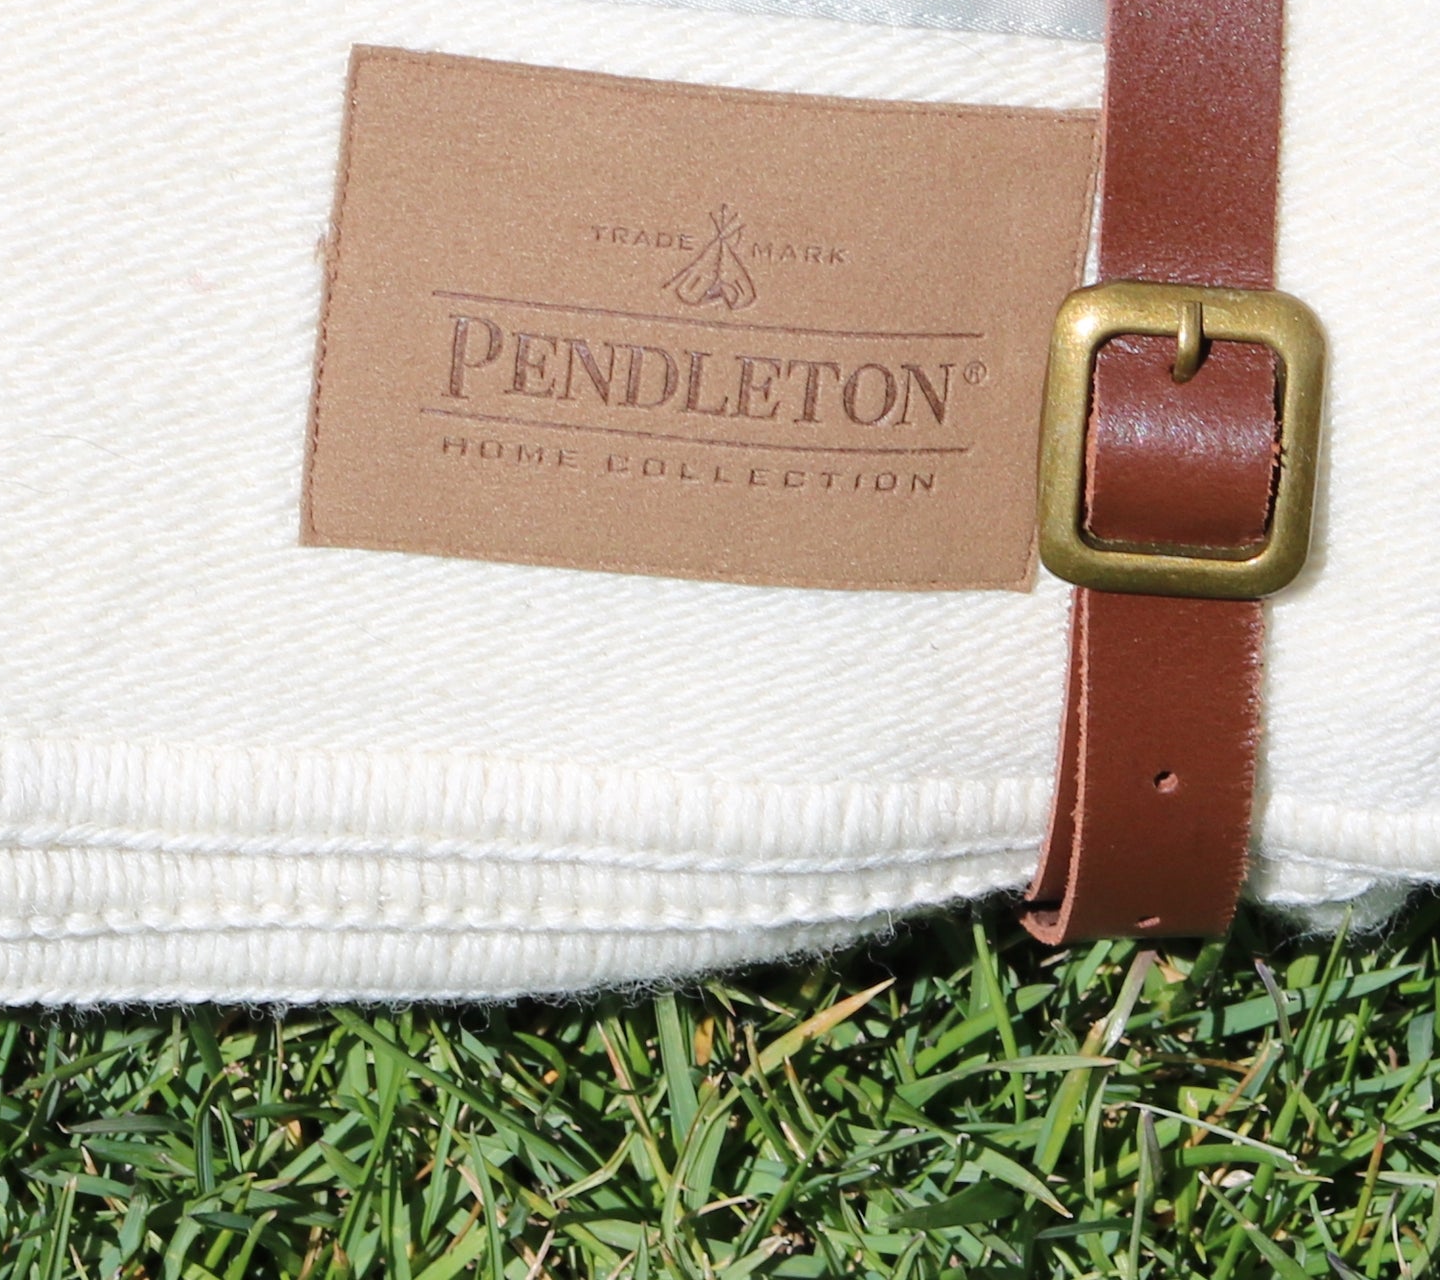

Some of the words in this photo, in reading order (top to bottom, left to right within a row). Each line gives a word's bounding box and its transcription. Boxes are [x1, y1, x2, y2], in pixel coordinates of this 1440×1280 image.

[591, 224, 696, 252] TRADE
[751, 243, 849, 264] MARK
[442, 435, 579, 469] HOME
[607, 452, 937, 492] COLLECTION
